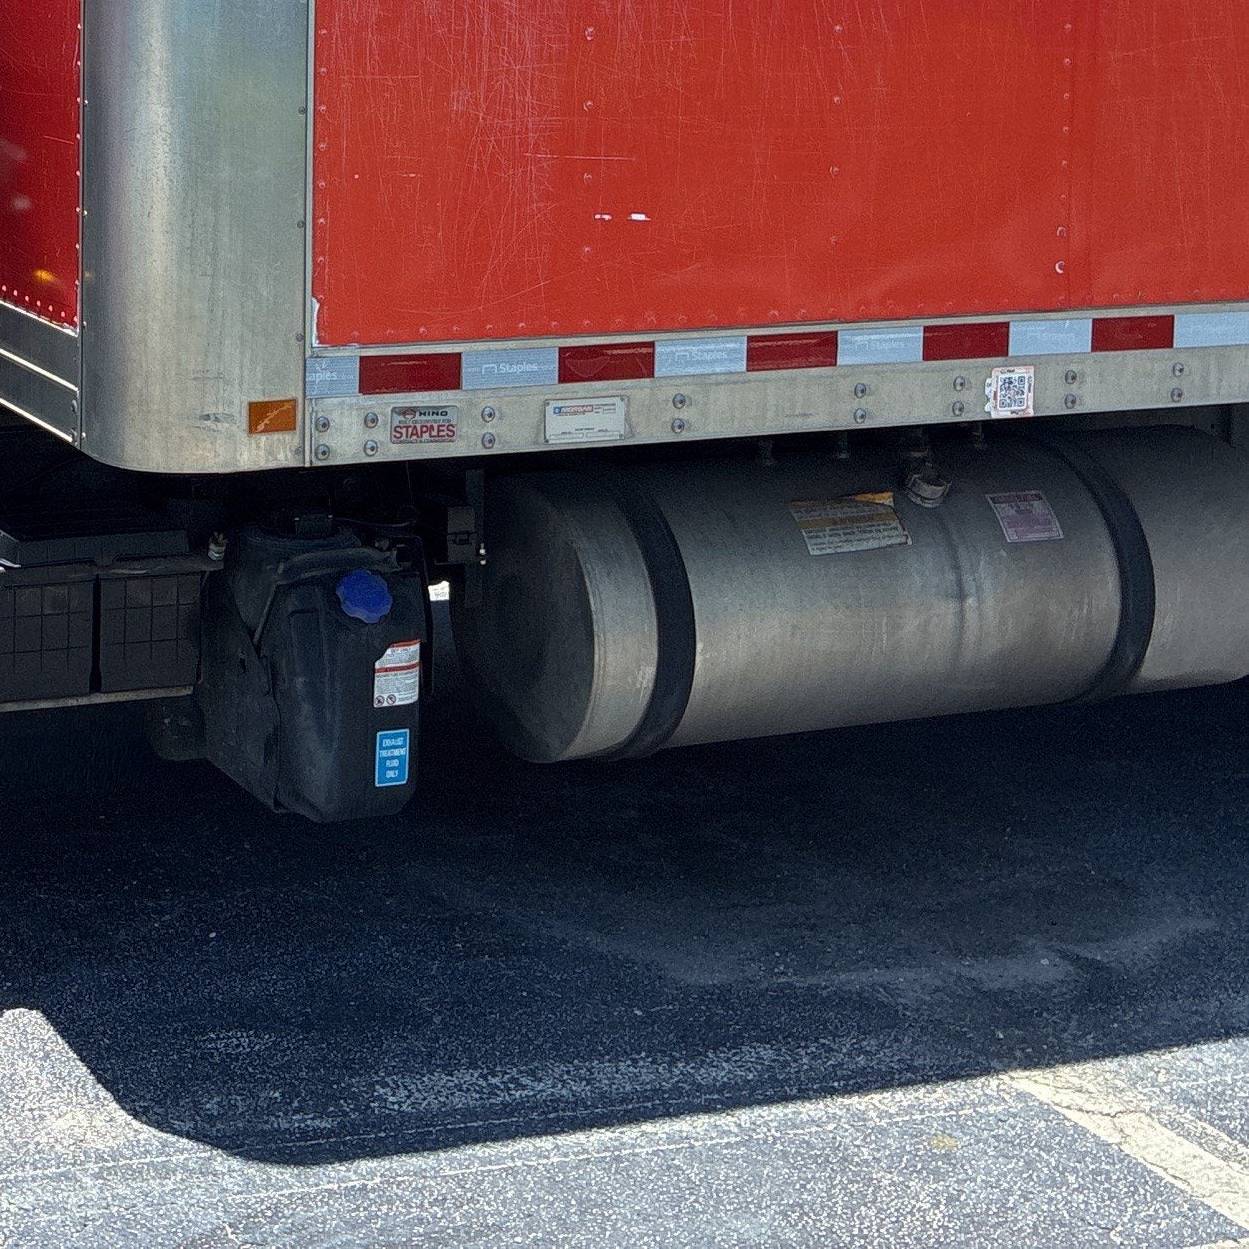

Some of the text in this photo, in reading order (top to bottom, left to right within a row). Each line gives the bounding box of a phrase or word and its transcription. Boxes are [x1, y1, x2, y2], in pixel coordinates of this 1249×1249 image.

[499, 362, 538, 375] Staples
[306, 369, 338, 384] aples
[393, 424, 456, 439] STAPLES
